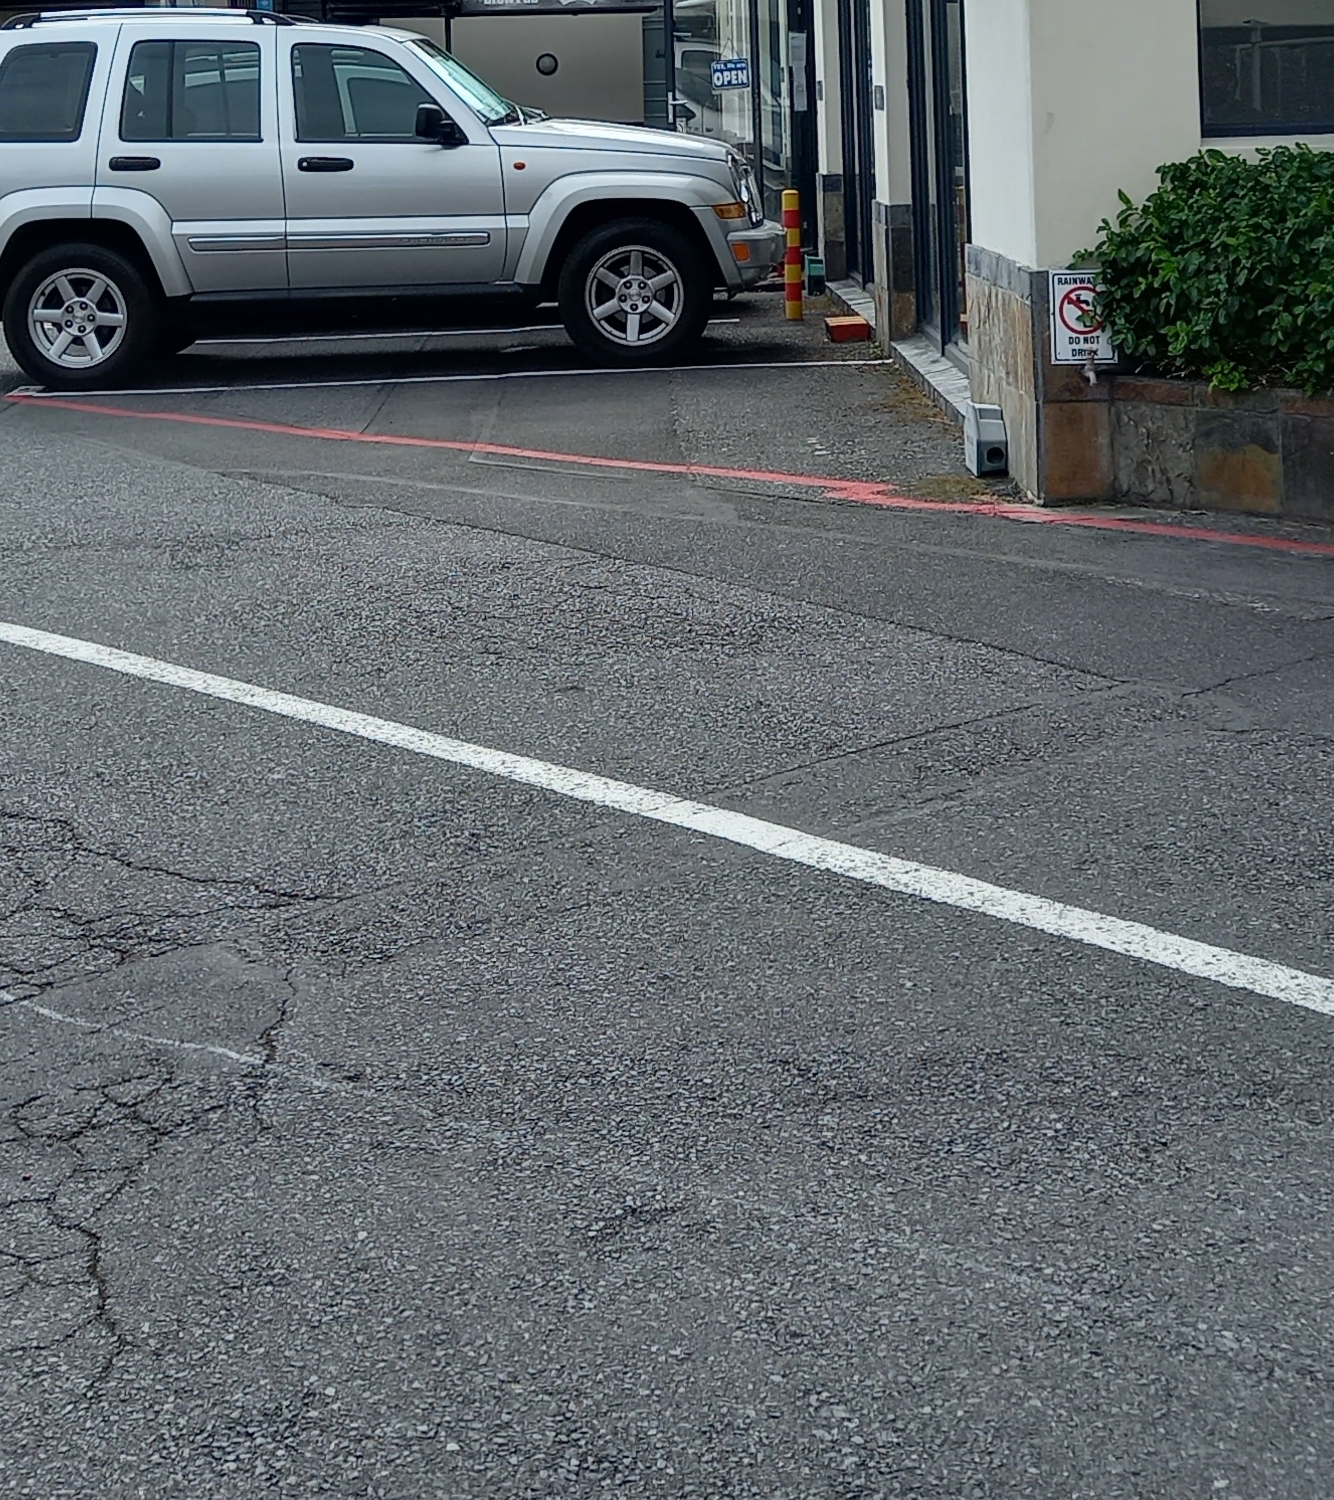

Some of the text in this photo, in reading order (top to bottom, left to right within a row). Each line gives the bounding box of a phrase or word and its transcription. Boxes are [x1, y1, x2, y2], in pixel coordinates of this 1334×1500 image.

[713, 70, 747, 86] OPEN
[1068, 335, 1101, 345] DO NOT
